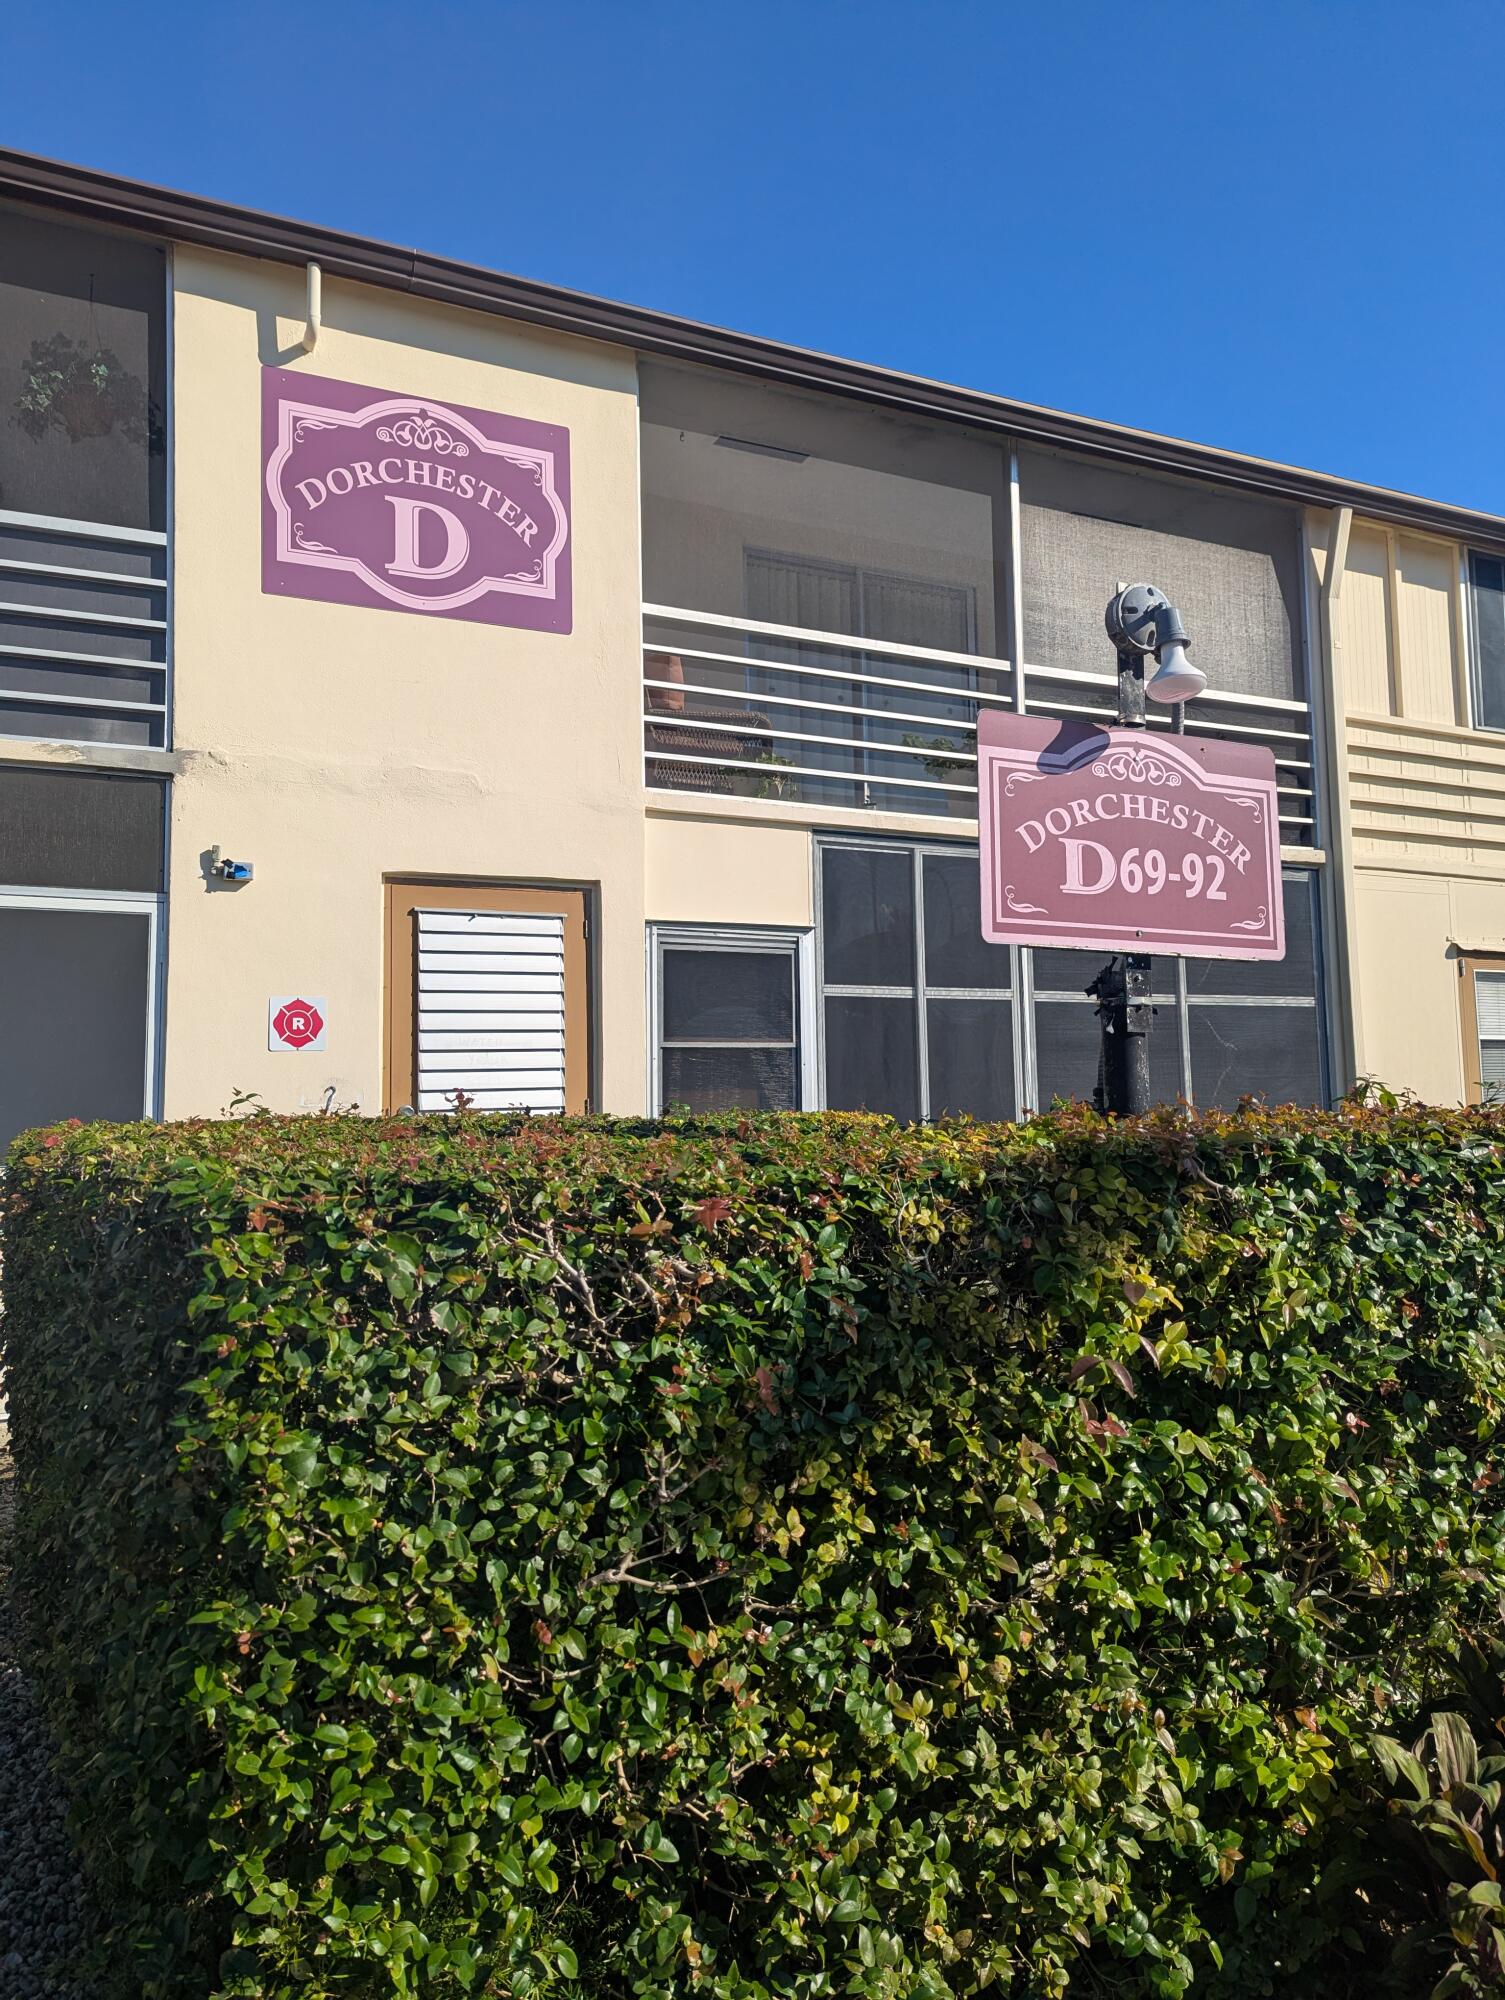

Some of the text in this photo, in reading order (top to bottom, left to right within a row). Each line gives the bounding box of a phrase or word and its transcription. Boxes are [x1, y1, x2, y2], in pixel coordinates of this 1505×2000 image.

[294, 457, 539, 548] DORCHESTER
[384, 494, 470, 580] D
[1014, 792, 1252, 875] DORCHESTER
[292, 1016, 306, 1031] R
